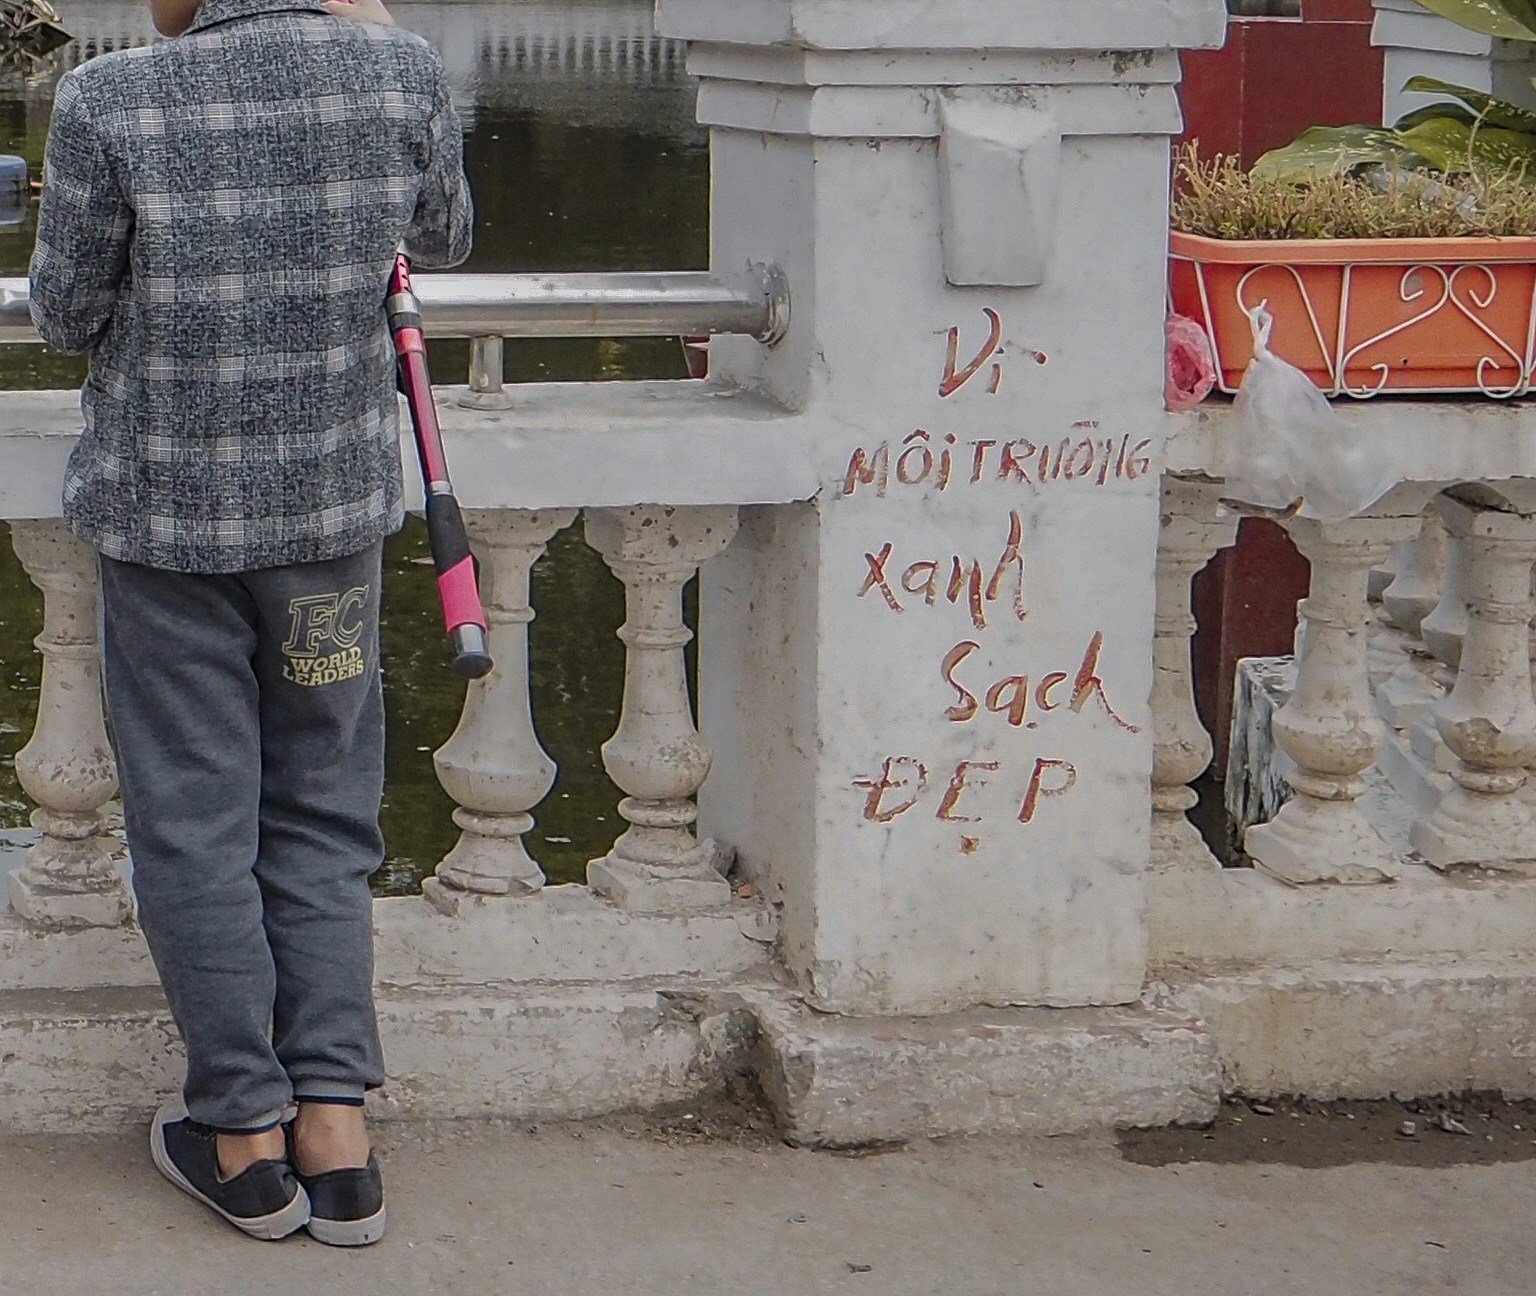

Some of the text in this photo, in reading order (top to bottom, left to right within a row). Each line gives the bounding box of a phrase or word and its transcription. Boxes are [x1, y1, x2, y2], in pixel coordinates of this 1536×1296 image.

[281, 584, 370, 658] FC
[282, 658, 365, 687] LEADERS
[290, 646, 362, 673] WORLD
[940, 630, 1142, 734] Sạch
[851, 756, 1078, 854] ĐẸP
